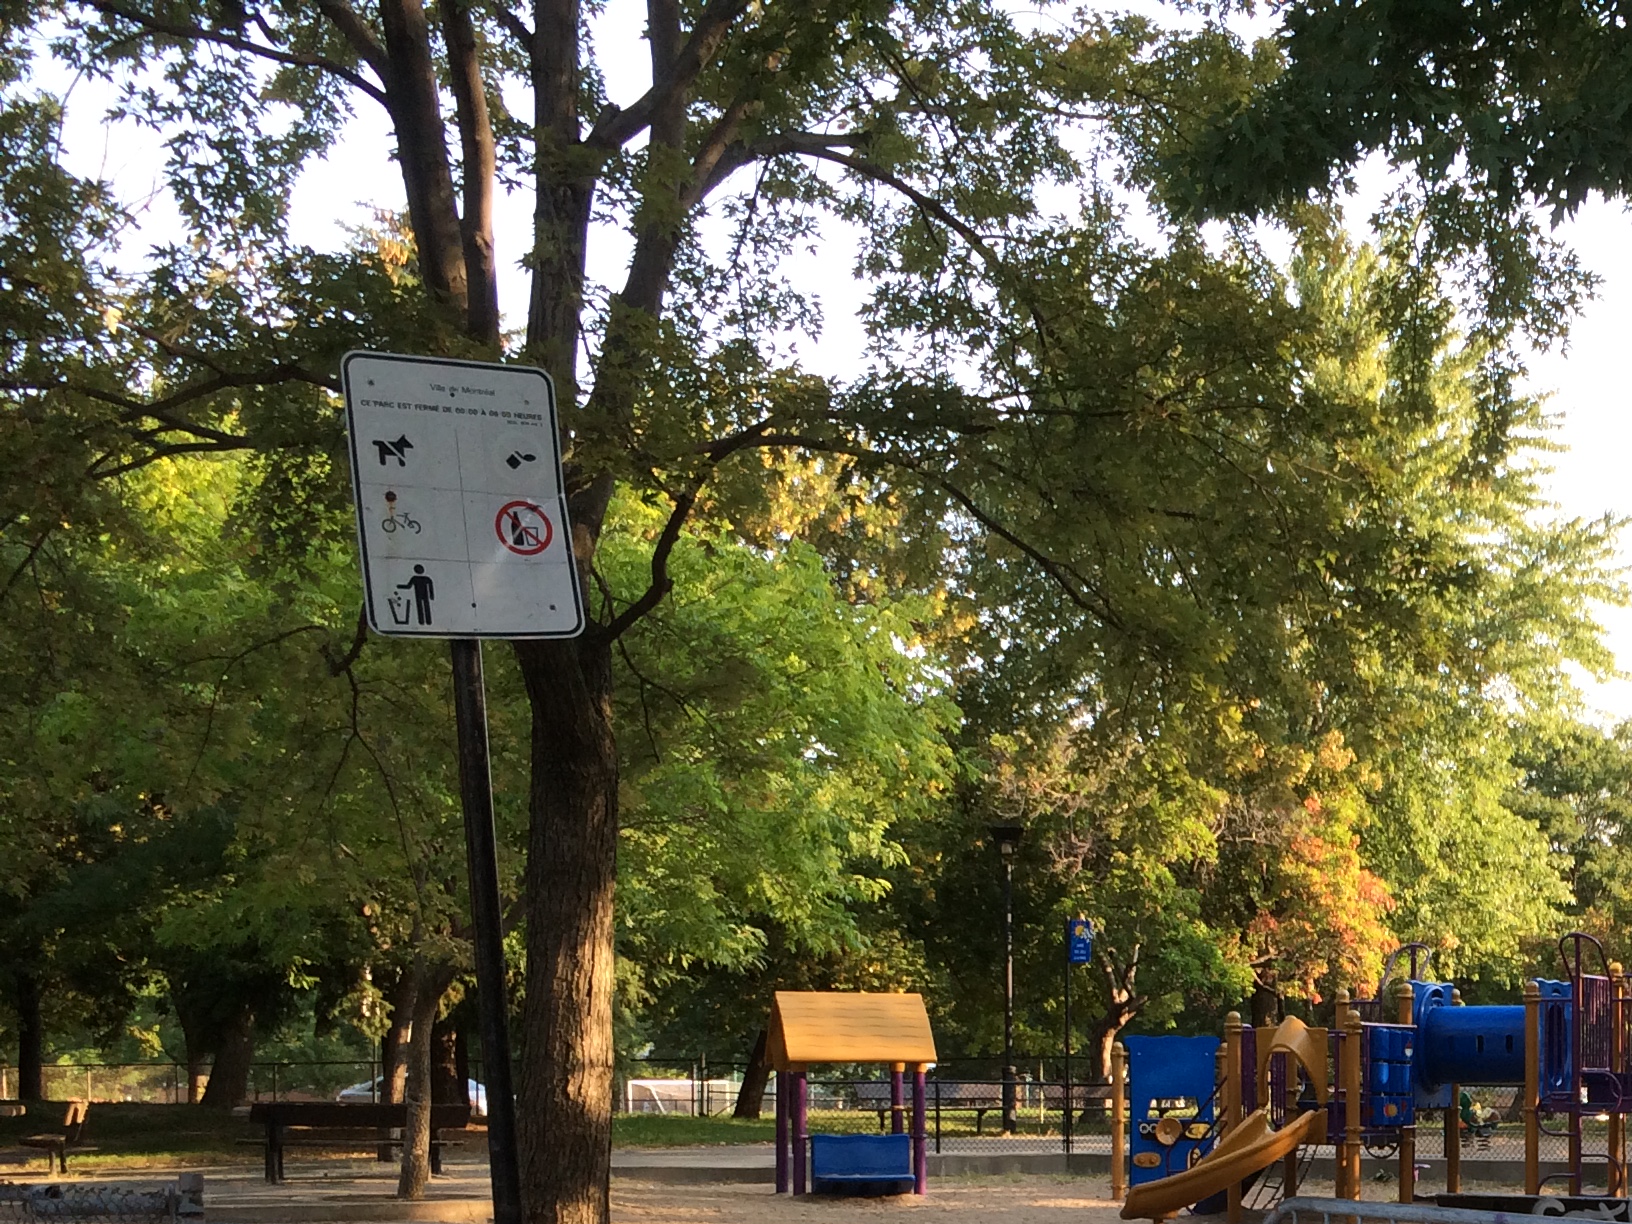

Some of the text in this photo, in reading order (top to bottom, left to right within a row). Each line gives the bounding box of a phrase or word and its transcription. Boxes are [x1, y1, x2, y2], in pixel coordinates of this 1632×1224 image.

[372, 400, 395, 409] PARC
[397, 402, 413, 410] EST
[513, 412, 543, 421] HEURES
